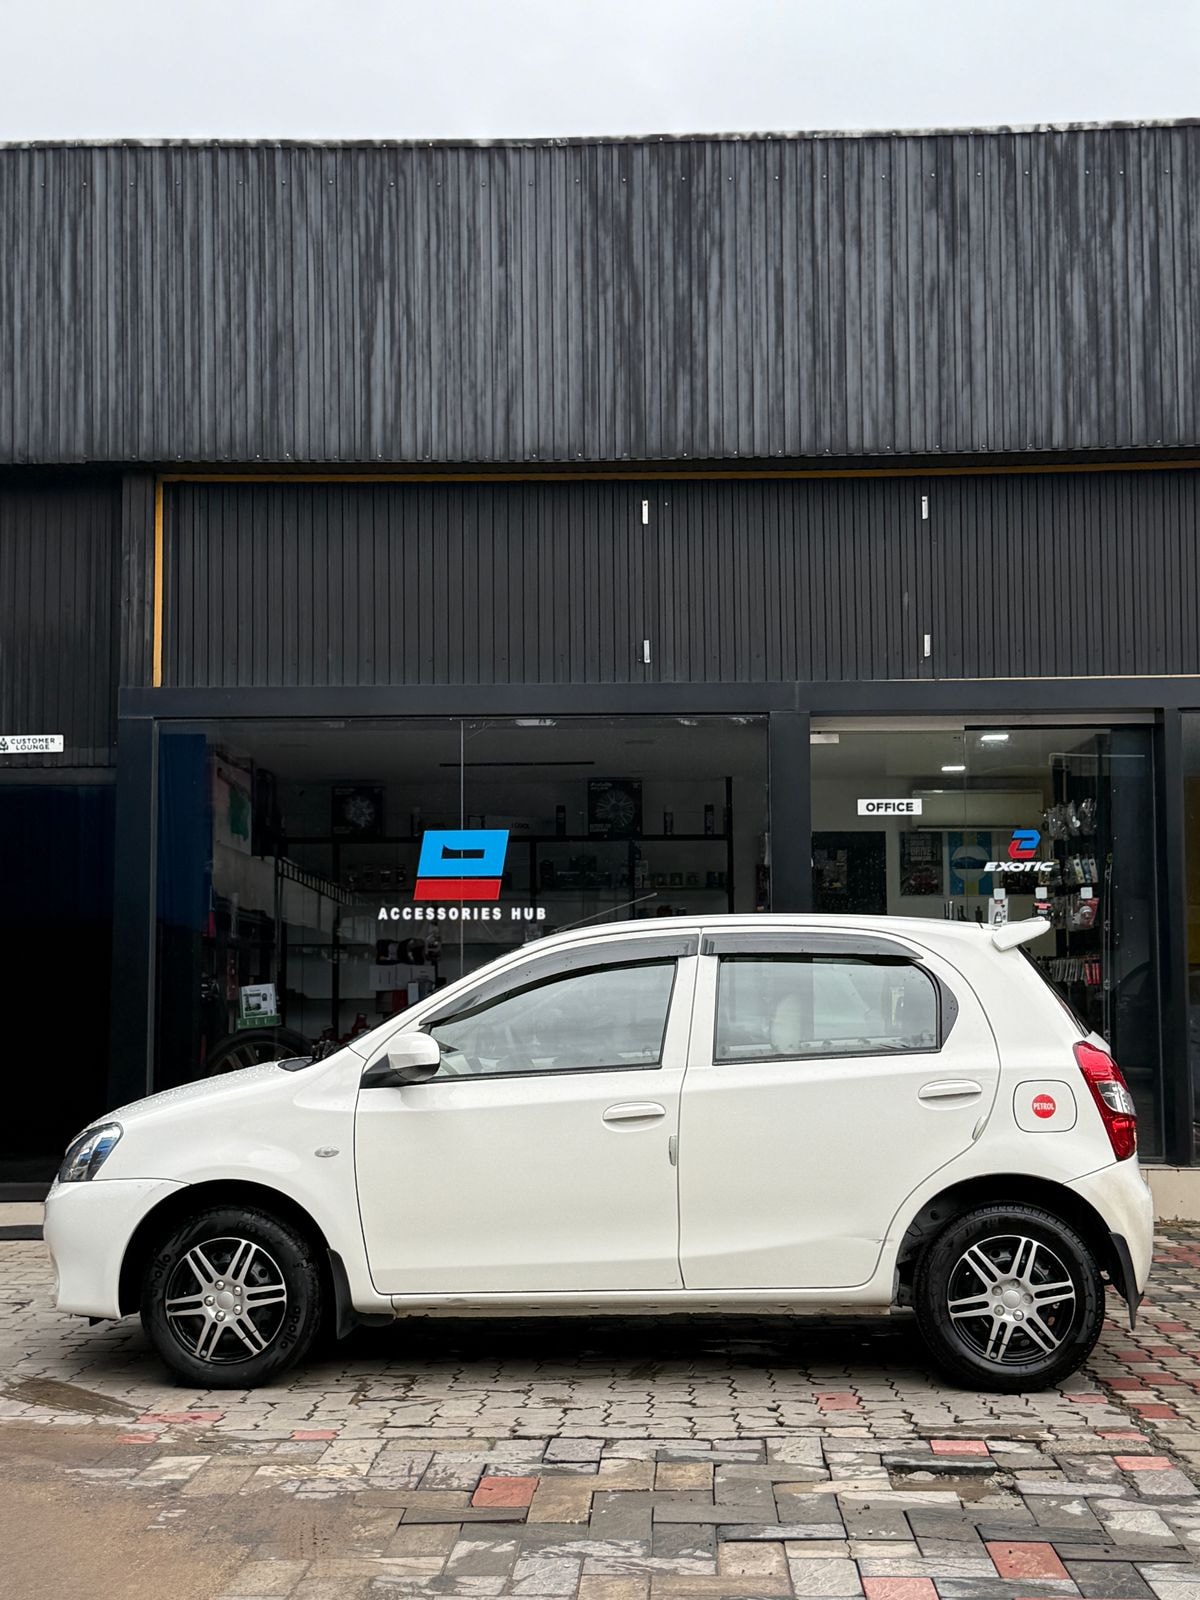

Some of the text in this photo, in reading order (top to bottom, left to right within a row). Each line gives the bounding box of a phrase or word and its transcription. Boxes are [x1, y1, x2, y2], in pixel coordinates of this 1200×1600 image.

[10, 737, 56, 745] CUSTOMER
[865, 802, 914, 812] OFFICE
[983, 861, 1055, 872] EXOTIC
[377, 907, 547, 920] ACCESSORIES HUB
[1033, 1102, 1055, 1111] PETROL
[280, 1306, 301, 1349] apollo
